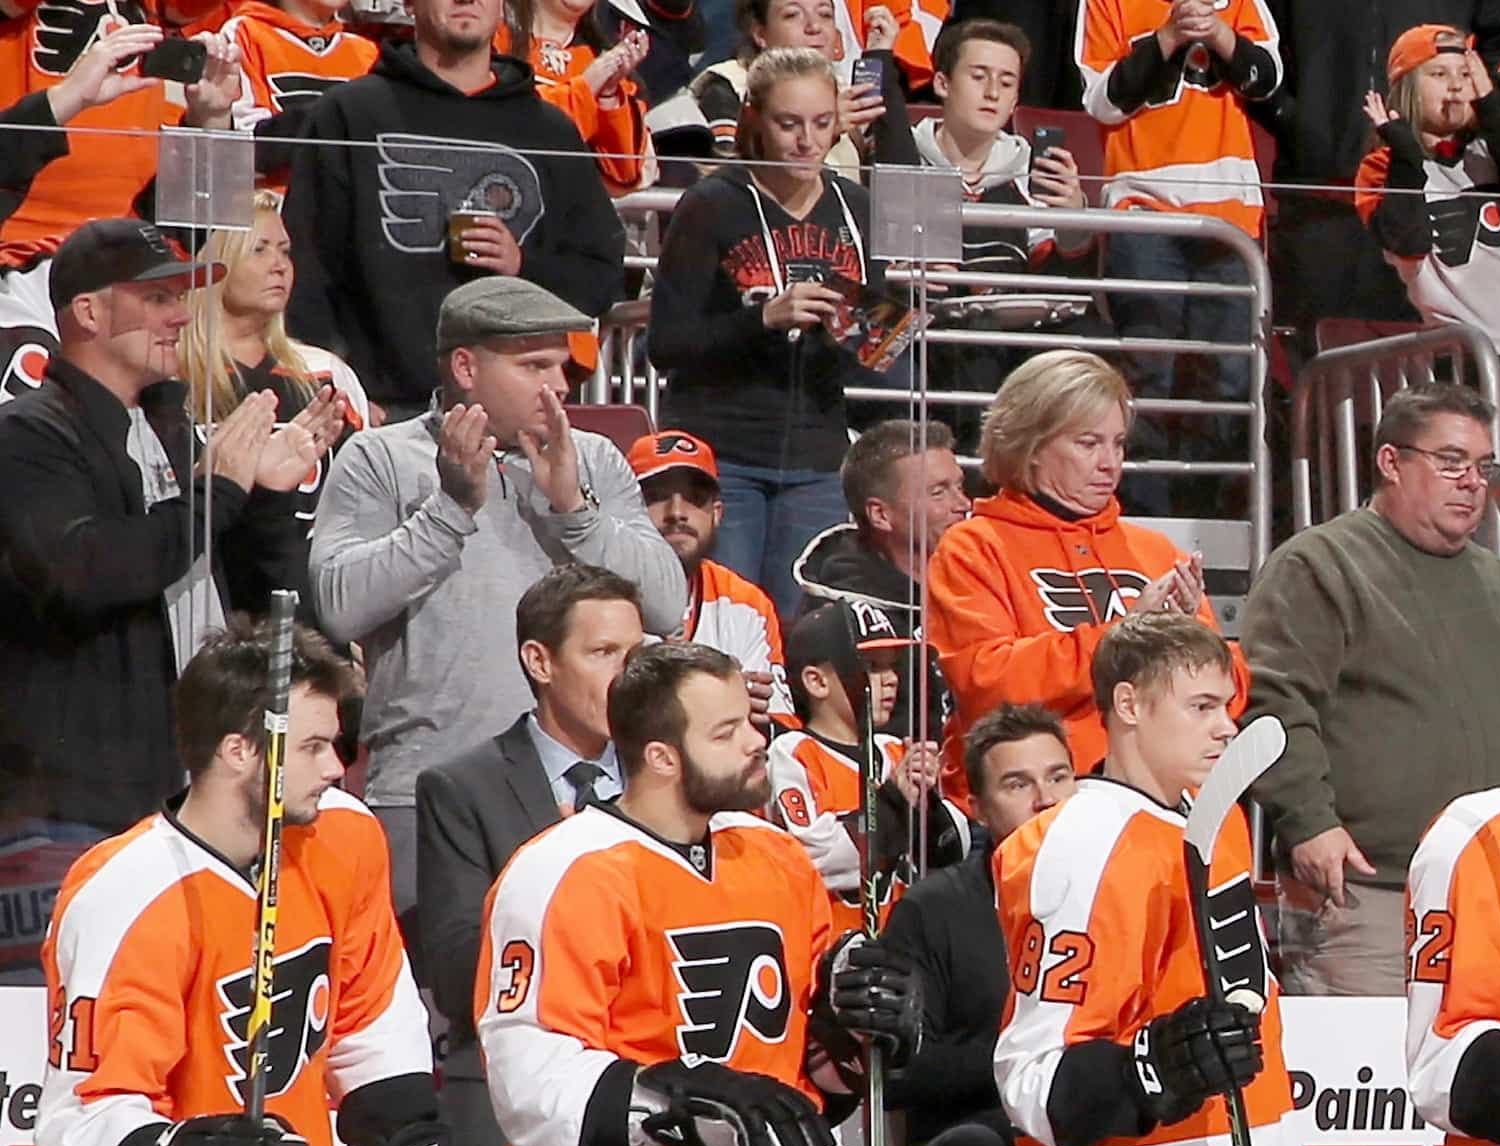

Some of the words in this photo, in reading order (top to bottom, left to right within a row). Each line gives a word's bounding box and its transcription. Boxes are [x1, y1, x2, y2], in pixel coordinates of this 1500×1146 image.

[497, 939, 535, 1014] 3
[1012, 918, 1096, 1006] 82
[1287, 1065, 1426, 1132] Pain
